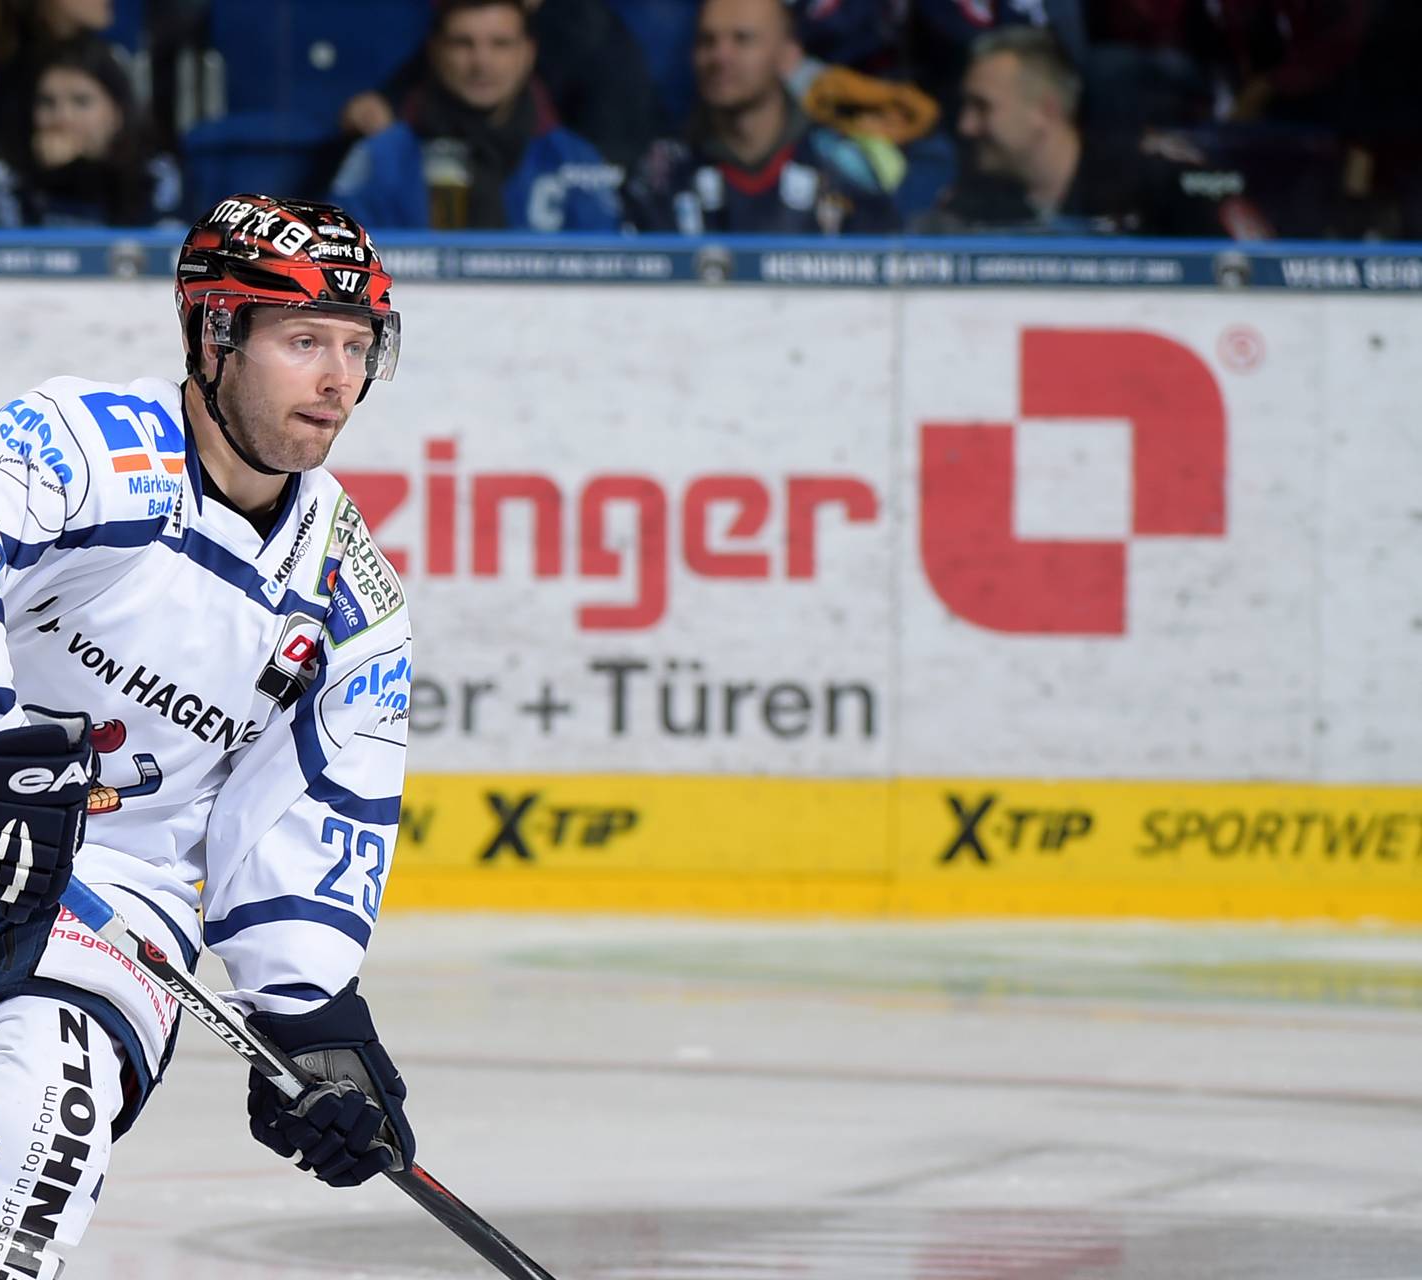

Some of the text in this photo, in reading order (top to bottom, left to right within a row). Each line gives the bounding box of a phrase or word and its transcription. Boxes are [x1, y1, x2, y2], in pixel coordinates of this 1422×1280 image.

[68, 632, 124, 685] VON
[589, 660, 879, 739] Türen
[314, 815, 386, 922] 23
[33, 1084, 59, 1136] Form
[21, 1141, 48, 1172] top
[9, 1178, 31, 1195] in
